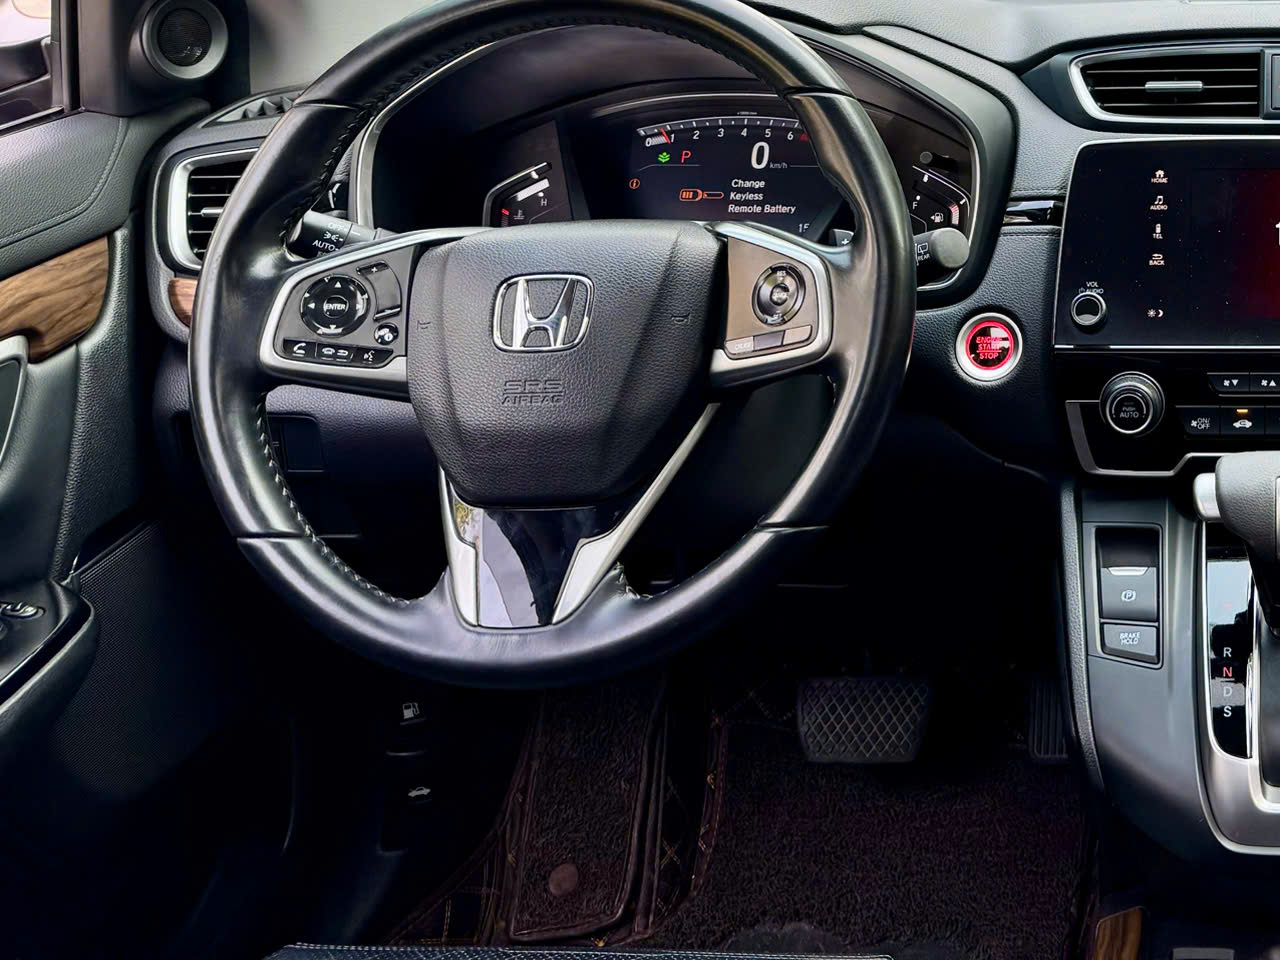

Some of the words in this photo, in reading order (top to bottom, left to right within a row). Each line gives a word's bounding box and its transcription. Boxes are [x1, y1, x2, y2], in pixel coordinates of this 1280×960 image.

[693, 131, 700, 140] 2
[717, 128, 725, 138] 3
[741, 128, 748, 137] 4
[765, 128, 772, 138] 5
[787, 131, 794, 141] 6
[680, 150, 692, 164] P
[751, 141, 770, 170] 0
[731, 179, 766, 189] Change
[730, 191, 764, 201] Keyless
[728, 204, 762, 213] Remote
[764, 204, 797, 215] Battery
[912, 201, 918, 210] F
[312, 240, 336, 252] AUTO
[917, 253, 930, 261] REAR
[979, 352, 999, 360] STOP
[504, 379, 563, 392] SRS
[1119, 631, 1141, 639] BRAKE
[1223, 647, 1232, 657] R
[1223, 666, 1233, 677] N
[1223, 687, 1232, 697] D
[1223, 706, 1232, 717] S
